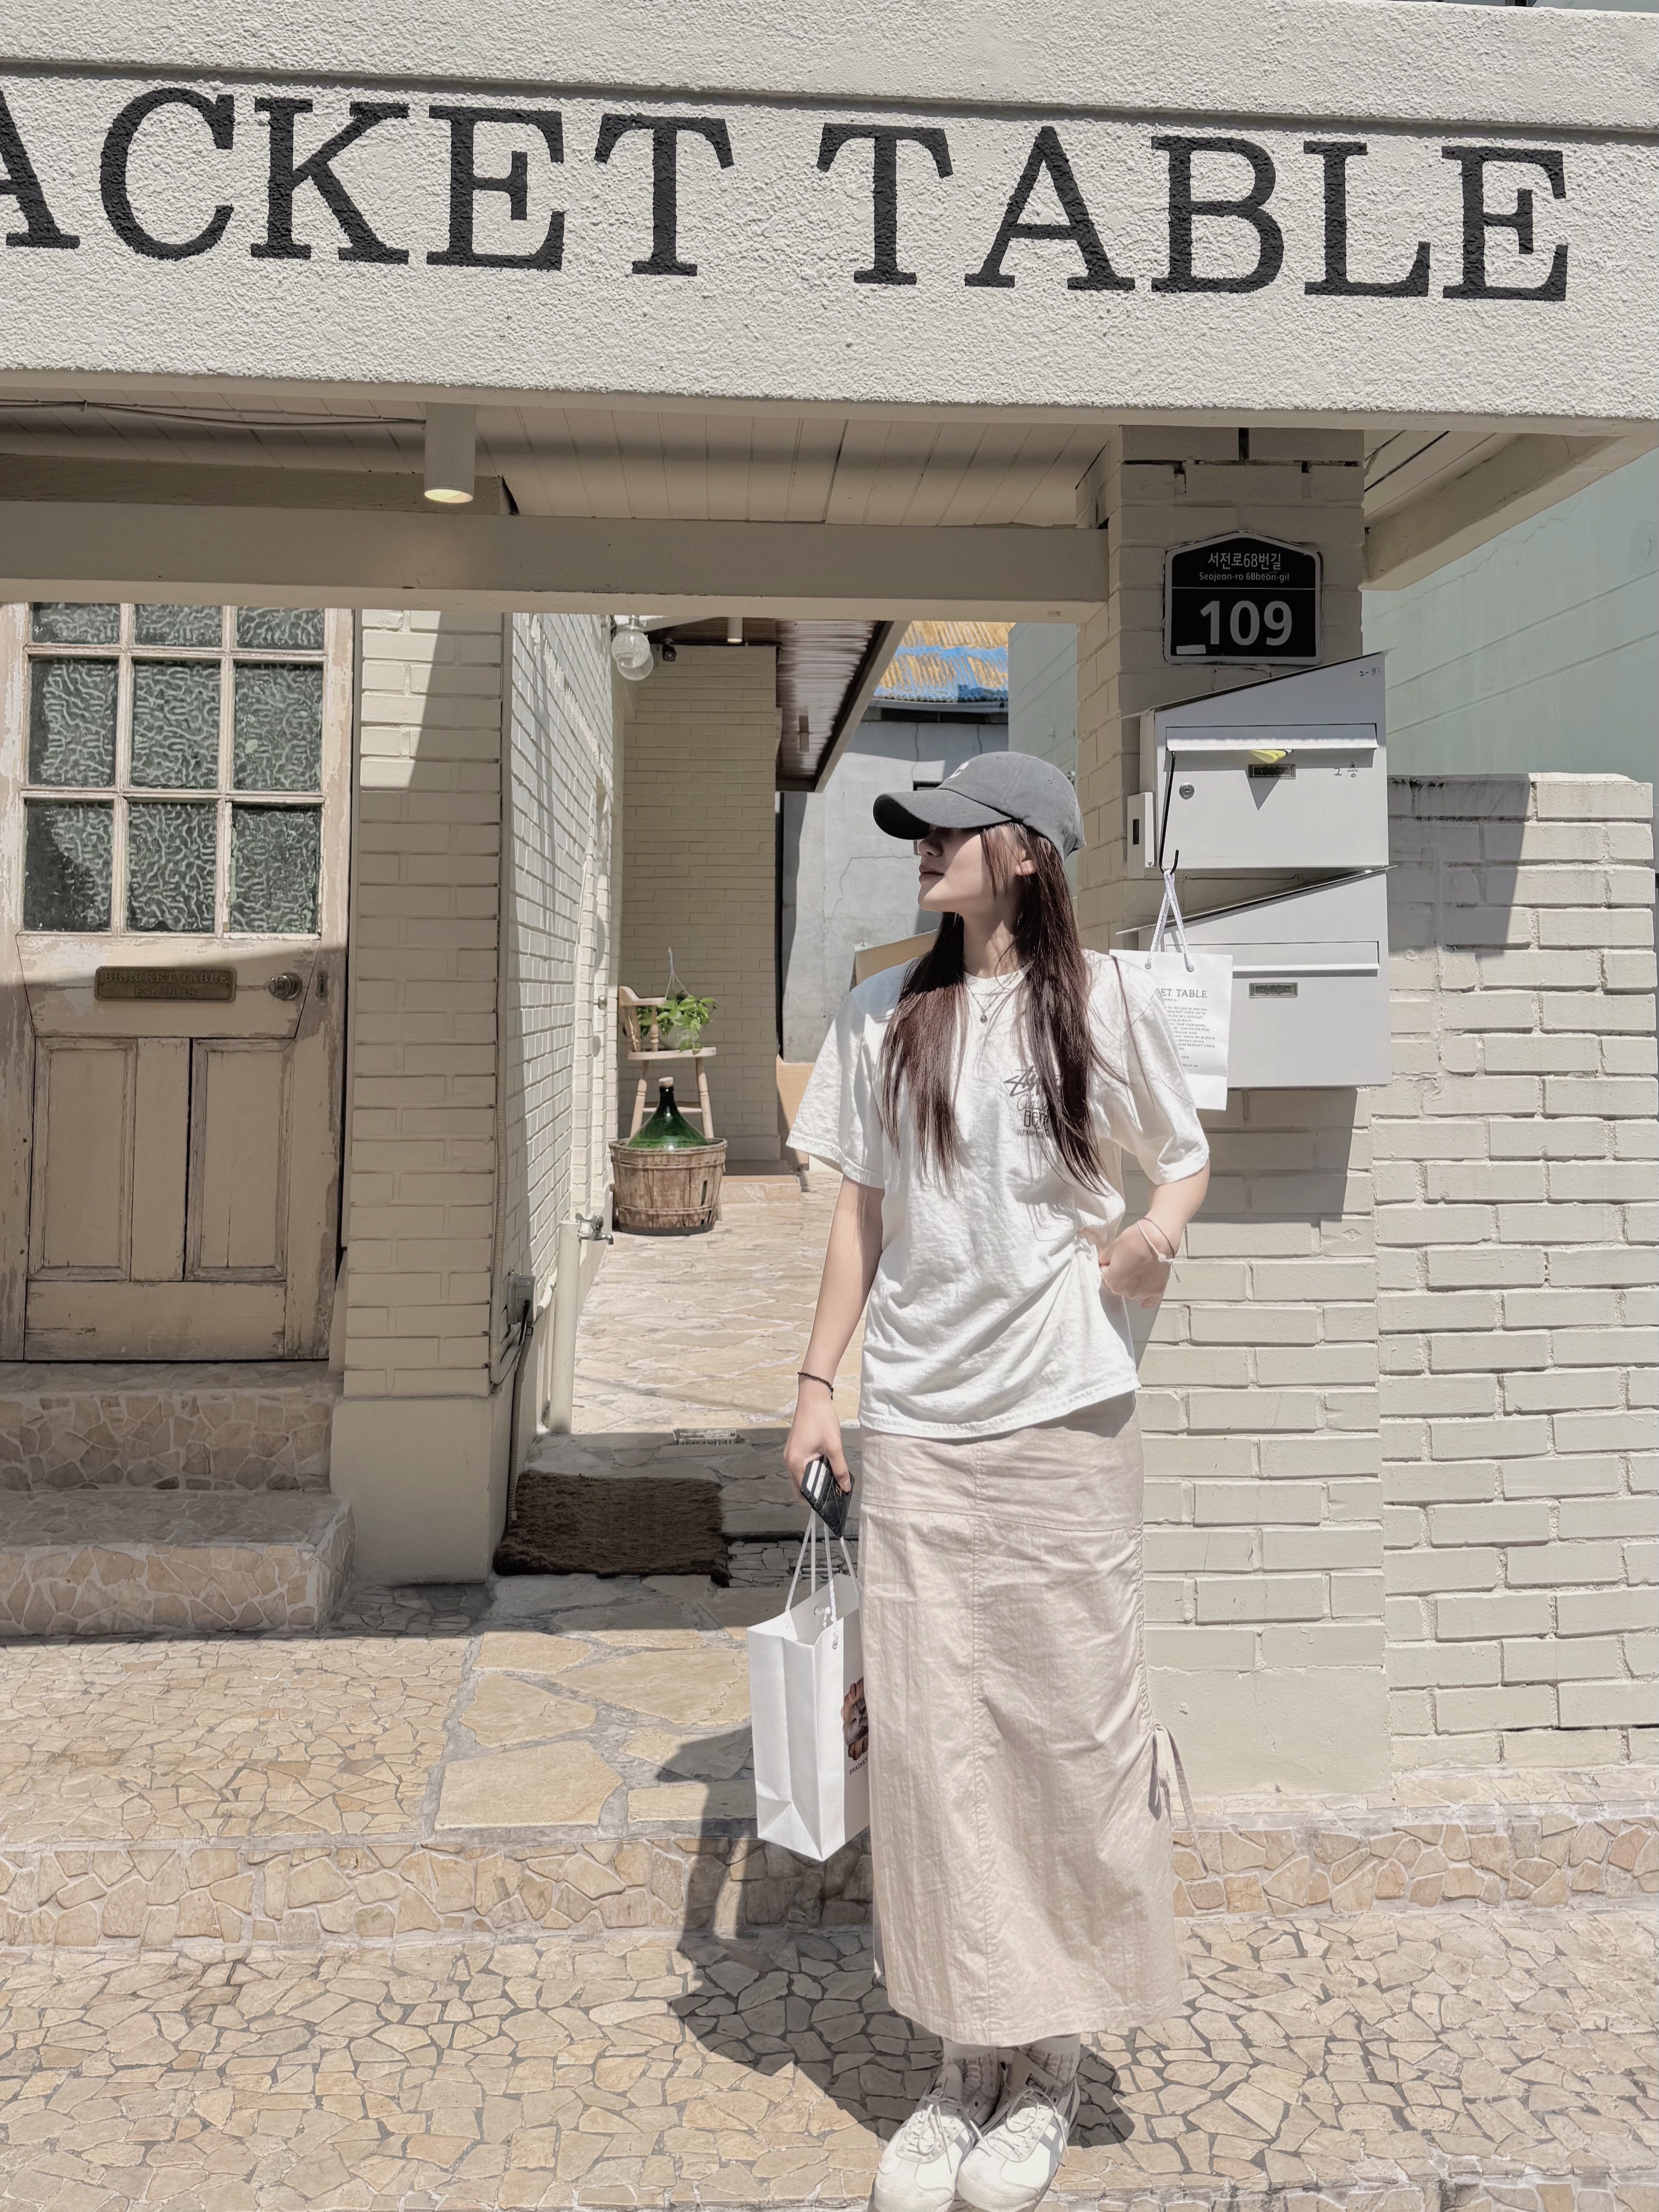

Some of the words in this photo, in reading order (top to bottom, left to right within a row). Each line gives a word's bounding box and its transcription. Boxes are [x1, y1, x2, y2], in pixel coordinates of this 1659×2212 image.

[816, 122, 1569, 301] TABLE
[1208, 552, 1281, 570] 서전로68번길
[1199, 572, 1244, 582] Seojeon-ro
[1246, 572, 1289, 583] 68beon-gil
[1200, 600, 1292, 646] 109
[104, 971, 174, 982] BRACKET
[179, 973, 228, 983] TABLE
[1176, 989, 1208, 998] TABLE
